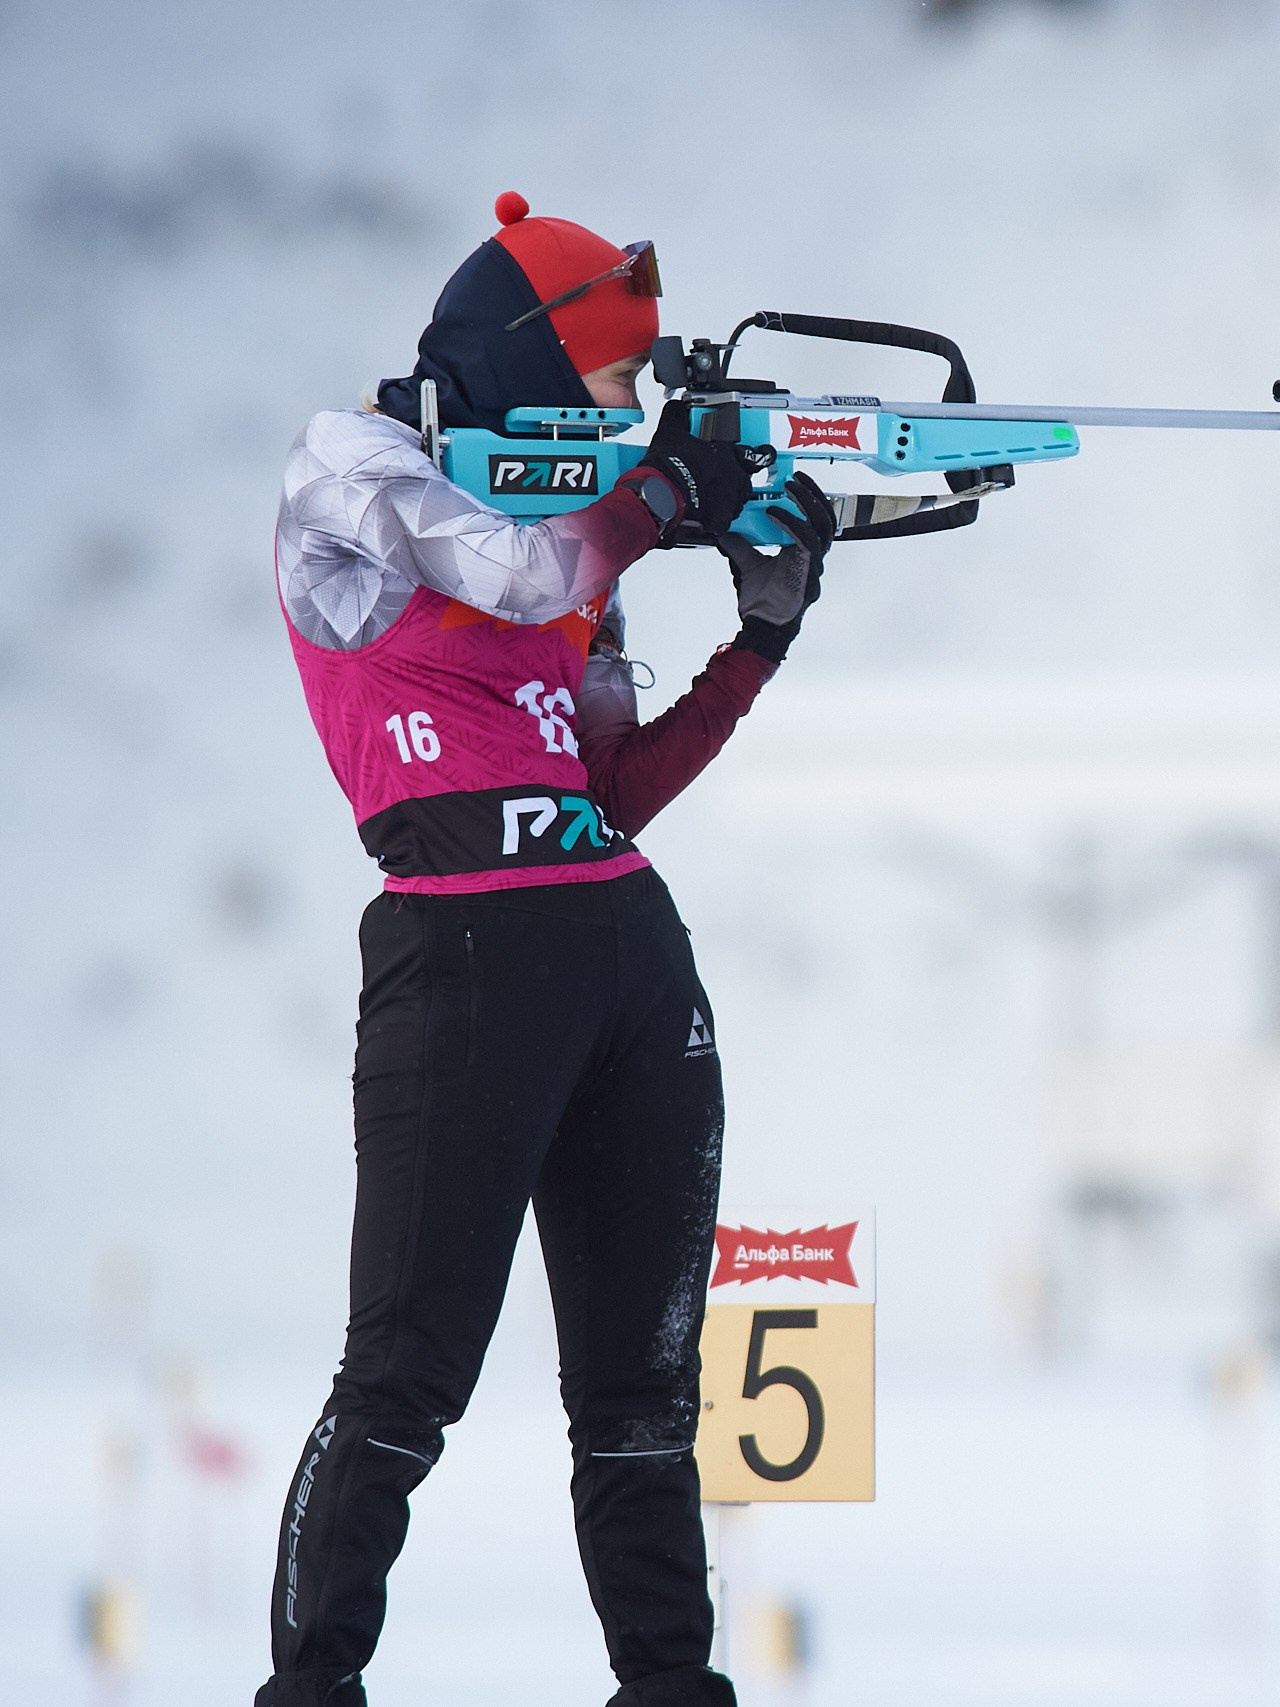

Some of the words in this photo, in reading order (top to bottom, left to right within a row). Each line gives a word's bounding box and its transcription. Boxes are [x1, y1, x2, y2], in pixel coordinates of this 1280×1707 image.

[836, 397, 879, 406] IZHMASH
[800, 426, 827, 437] Альфа
[827, 427, 849, 437] Банк
[494, 461, 594, 488] PARI
[385, 710, 441, 764] 16
[734, 1244, 790, 1266] Альфа
[792, 1244, 834, 1261] Банк
[738, 1308, 825, 1482] 5
[286, 1451, 321, 1629] FISCHER
